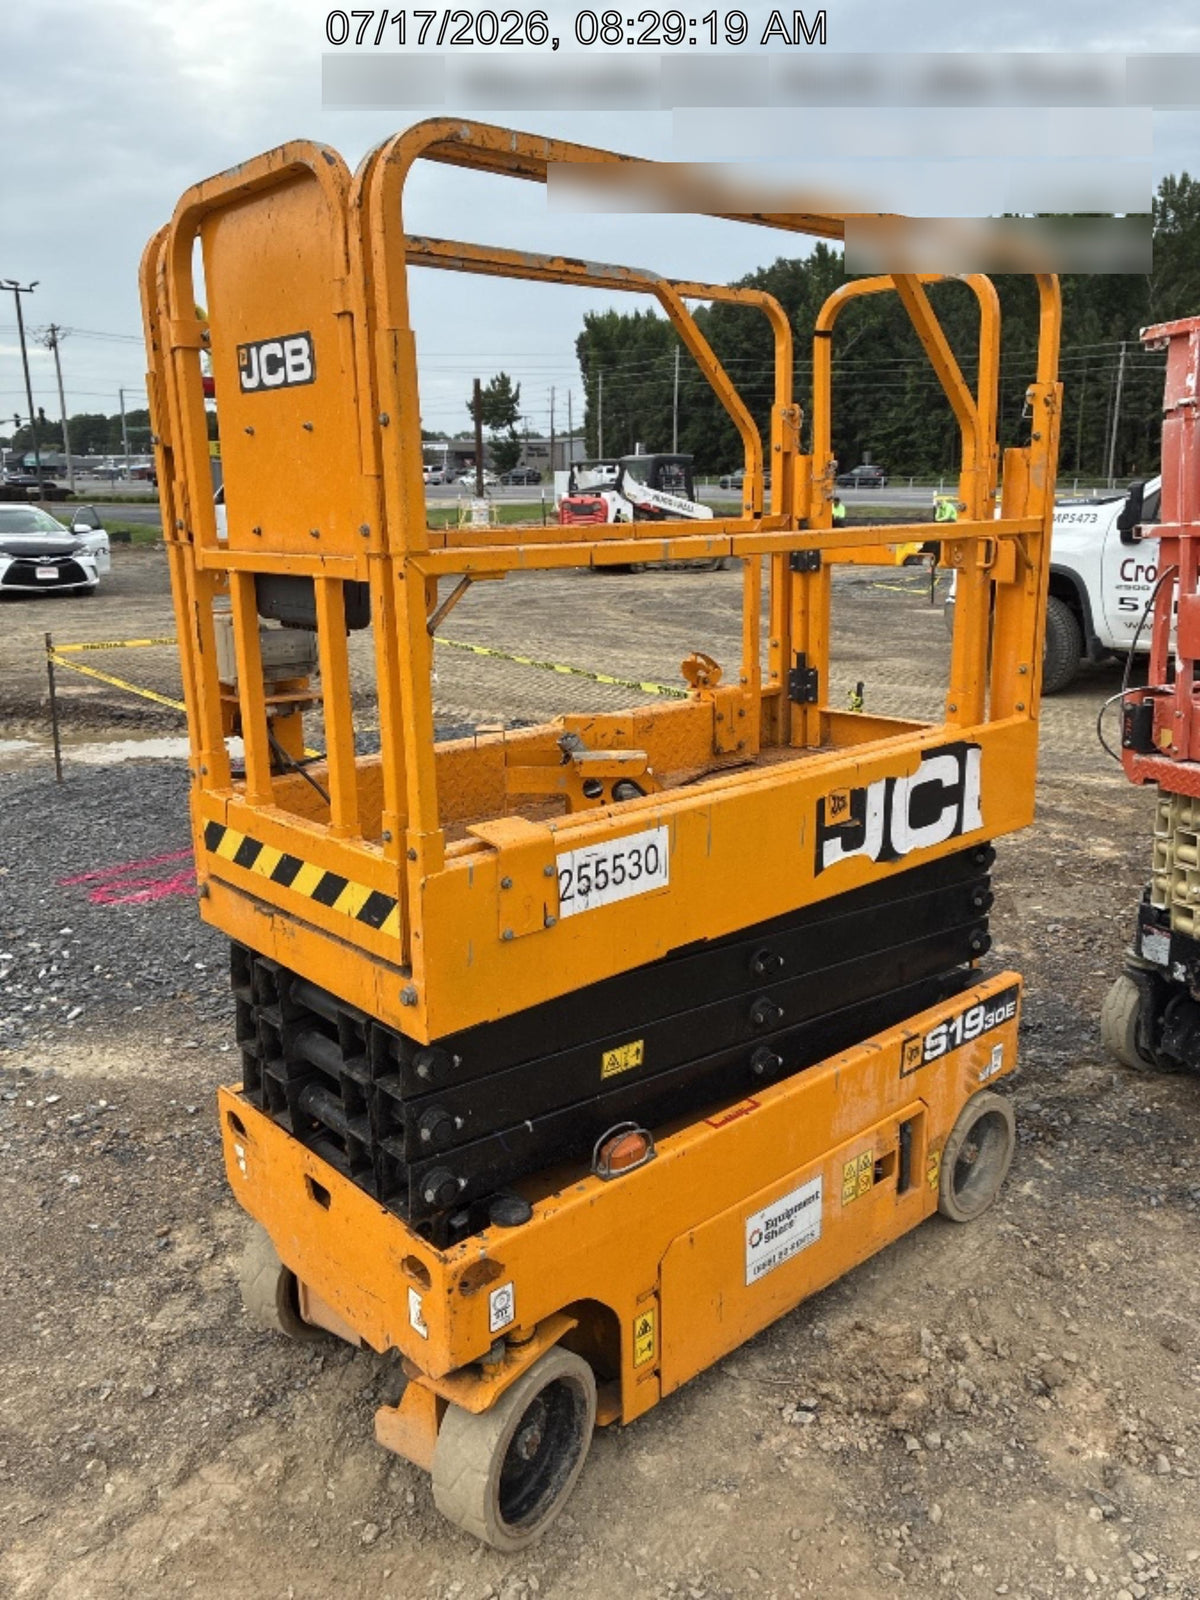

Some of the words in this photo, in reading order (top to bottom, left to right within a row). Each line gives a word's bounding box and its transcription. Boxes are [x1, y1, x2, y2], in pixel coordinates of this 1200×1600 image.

[241, 337, 312, 388] JCB
[559, 843, 659, 901] 255530
[764, 1190, 821, 1232] Equipment
